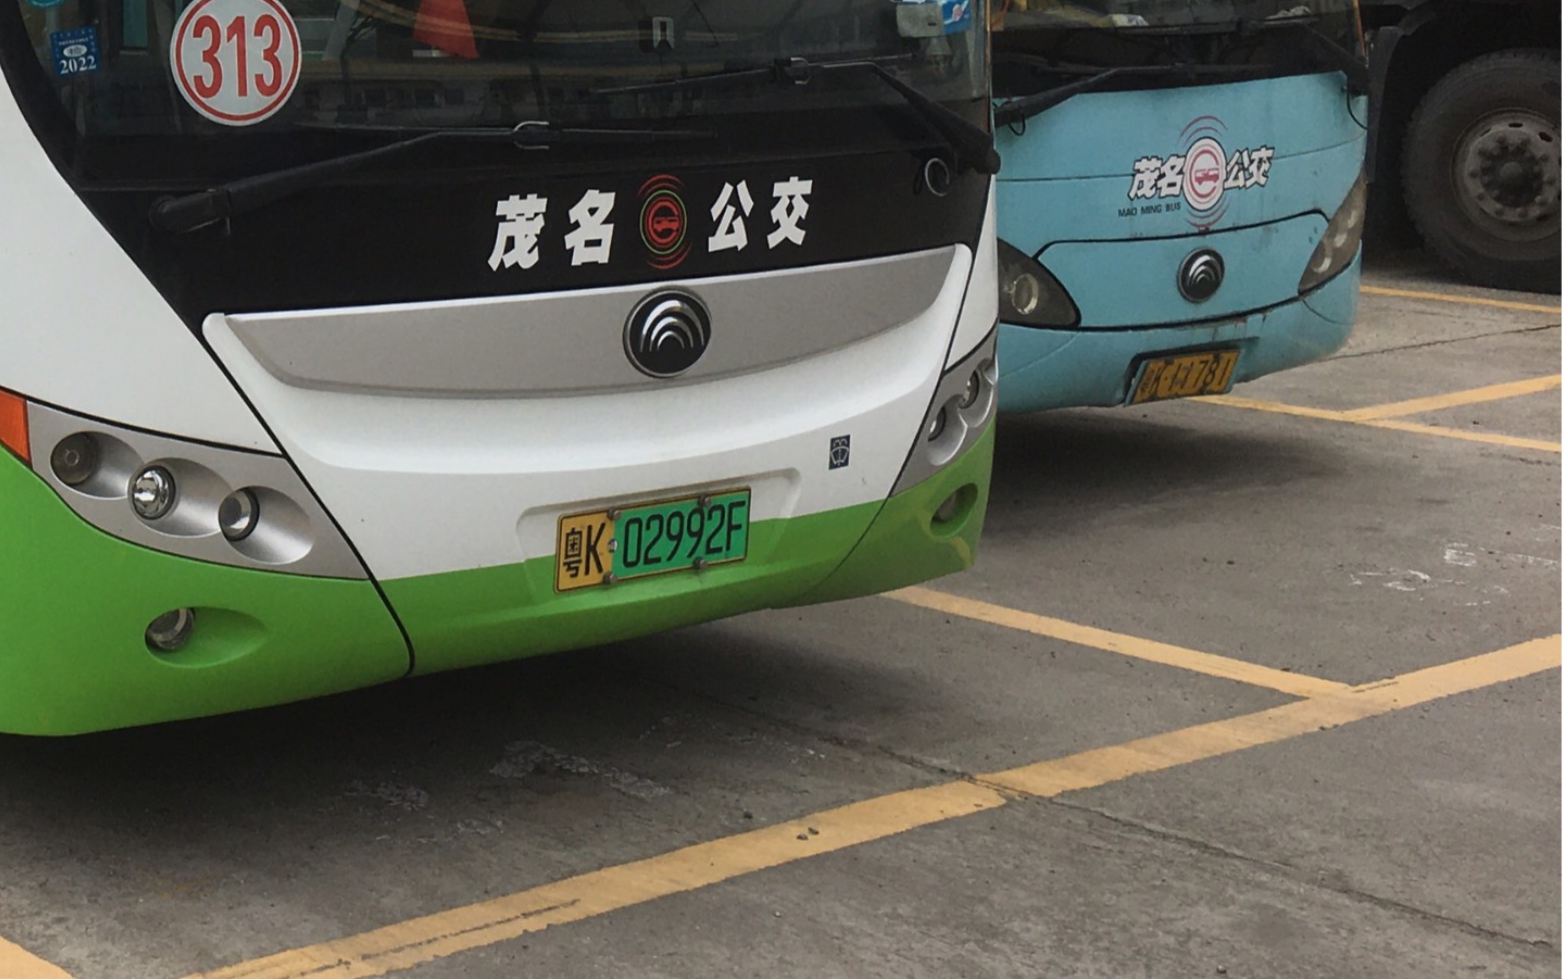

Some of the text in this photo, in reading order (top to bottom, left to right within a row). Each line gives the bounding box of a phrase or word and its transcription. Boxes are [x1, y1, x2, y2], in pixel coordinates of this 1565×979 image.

[59, 55, 97, 75] 2022
[192, 13, 283, 99] 313
[1128, 145, 1275, 201] 茂名 公交
[487, 176, 813, 272] 茂名 公交
[1118, 202, 1181, 218] MAO MING BUS
